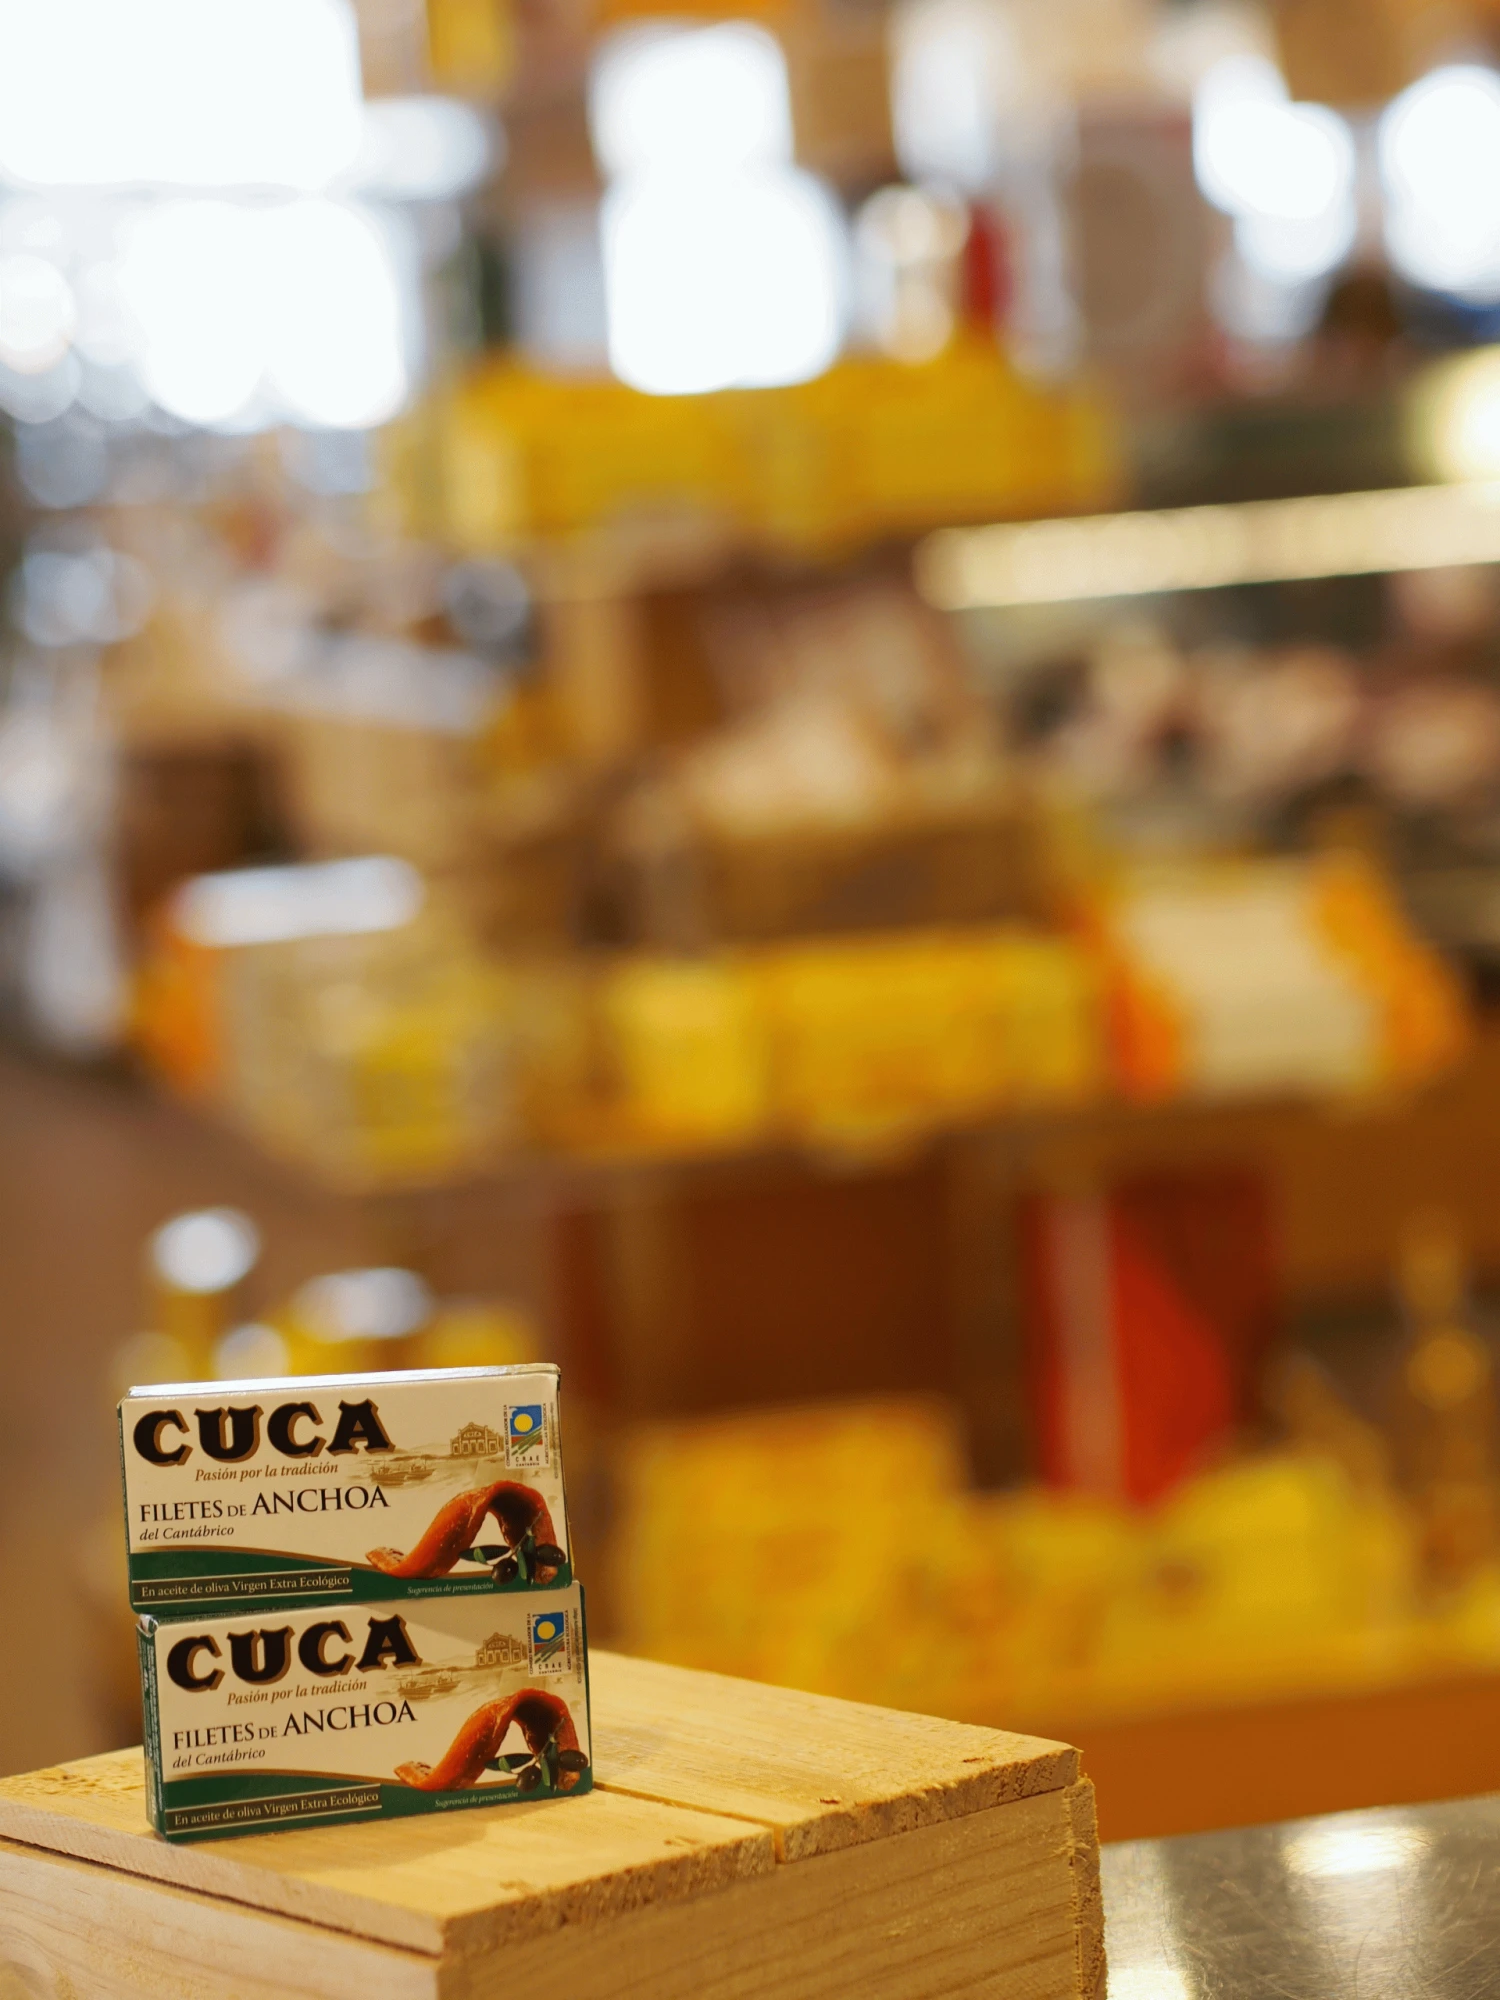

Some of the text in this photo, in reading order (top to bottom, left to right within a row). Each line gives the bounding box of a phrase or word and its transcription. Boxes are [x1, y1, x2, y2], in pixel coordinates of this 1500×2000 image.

[133, 1398, 396, 1467] CUCA
[195, 1462, 339, 1482] Pasión por la tradición
[140, 1485, 391, 1522] FILETES DE ANCHOA
[139, 1524, 235, 1541] del Cantábrico
[141, 1575, 350, 1597] En aceite de oliva Virgen Extra Ecológico
[407, 1585, 442, 1596] Sugerencia
[443, 1584, 452, 1592] de
[166, 1613, 423, 1693] CUCA
[227, 1679, 367, 1706] Pasión por la tradición
[173, 1700, 418, 1750] FILETES DE ANCHOA
[172, 1749, 266, 1769] del Cantábrico
[174, 1793, 379, 1826] En aceite de oliva Virgen Extra Ecológico
